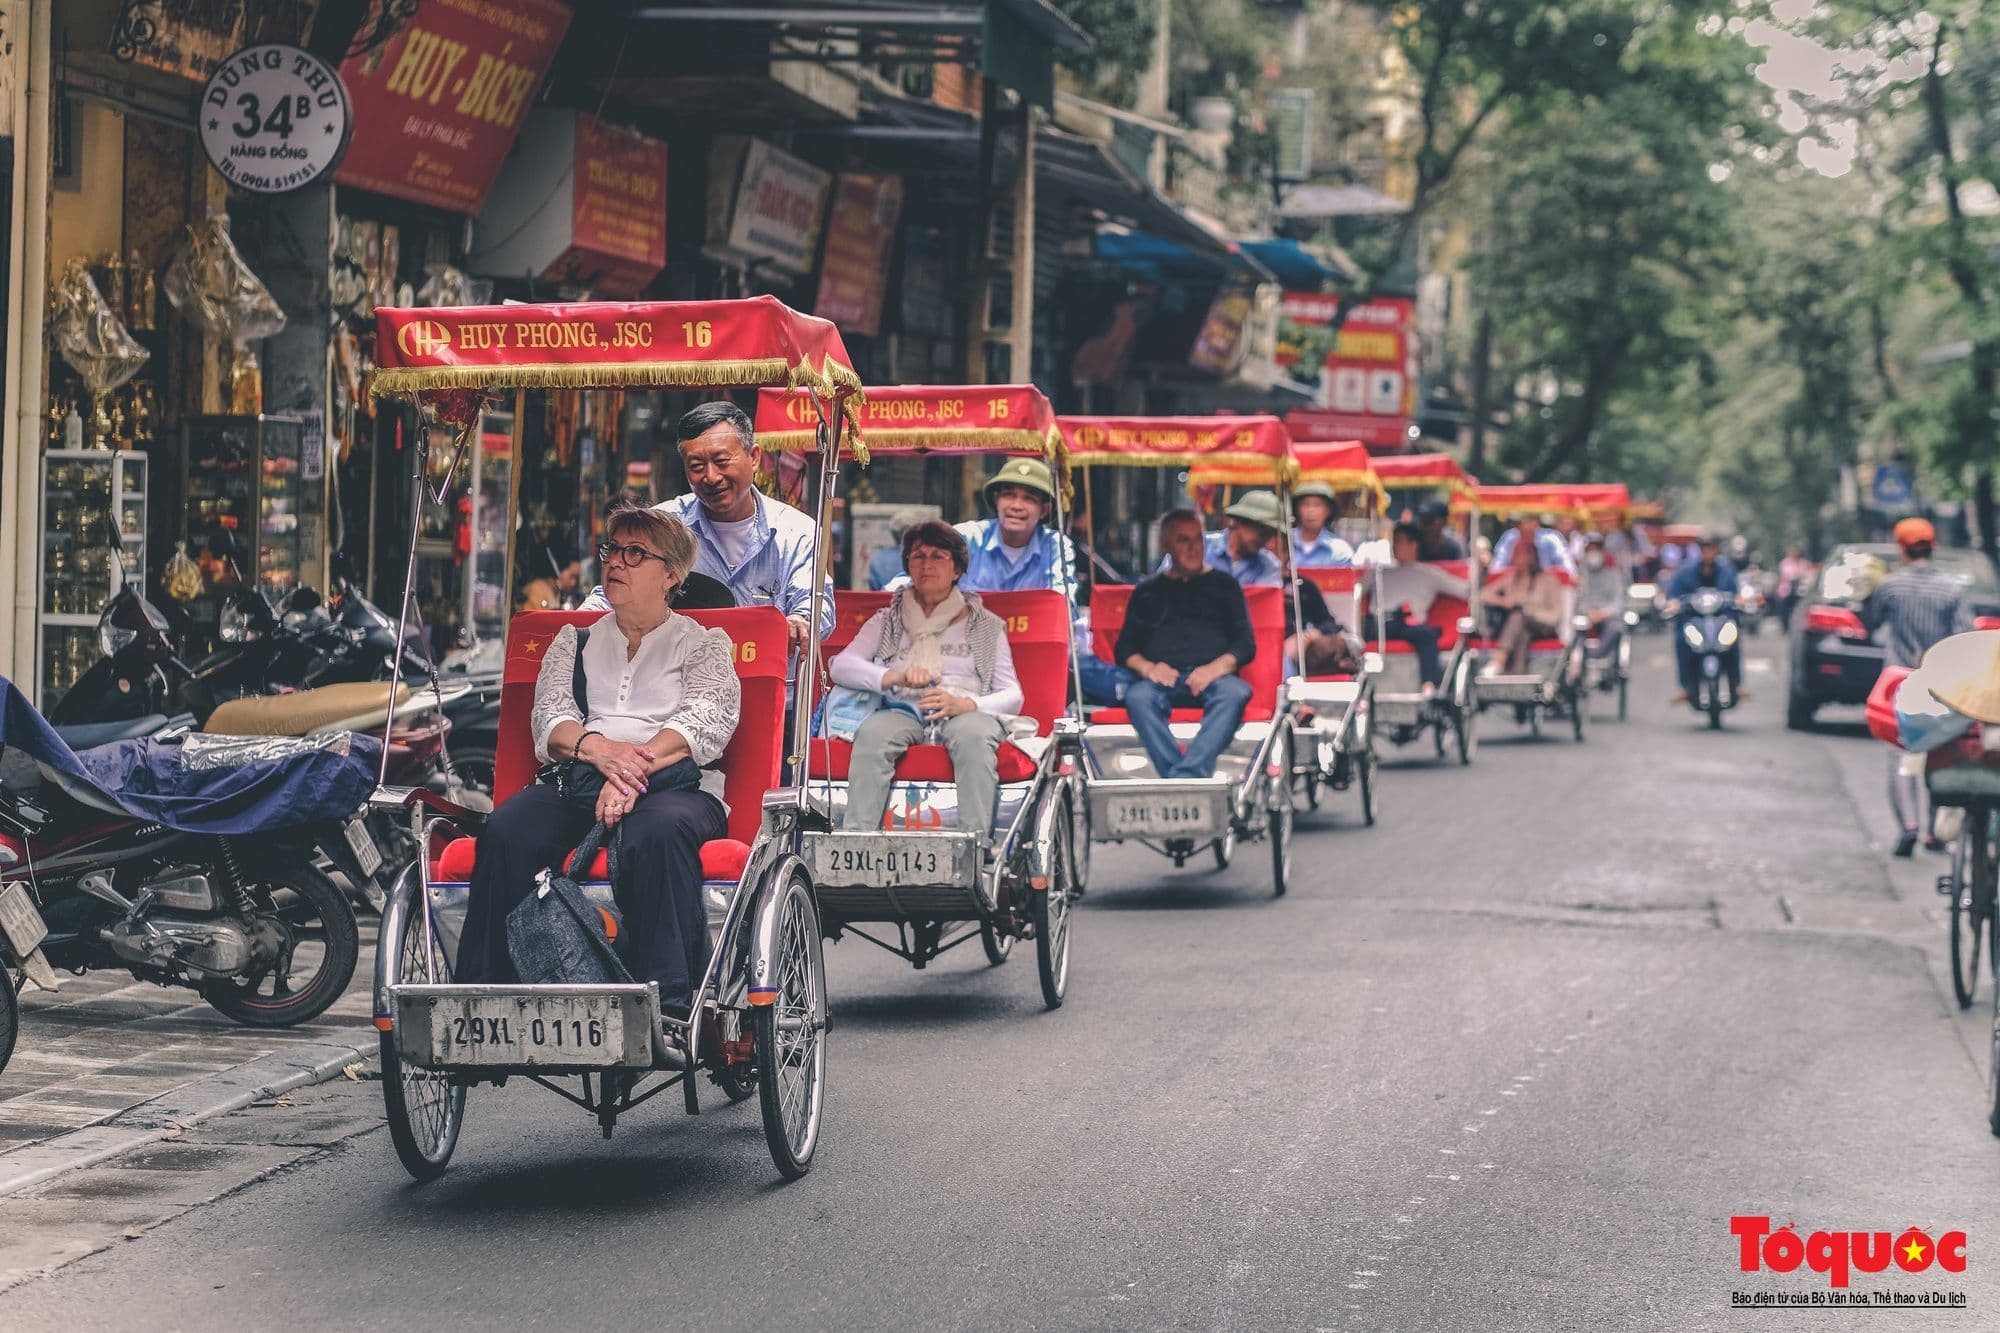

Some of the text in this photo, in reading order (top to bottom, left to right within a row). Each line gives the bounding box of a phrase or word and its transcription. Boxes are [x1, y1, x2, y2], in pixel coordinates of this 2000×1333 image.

[293, 54, 338, 108] THU
[386, 27, 467, 105] HUY
[455, 40, 535, 128] BÍCH
[457, 323, 508, 350] HUY
[612, 321, 653, 348] JSC
[681, 321, 712, 348] 16
[935, 399, 964, 420] JSC
[987, 398, 1009, 419] 15
[1007, 615, 1029, 633] 15
[453, 1017, 602, 1047] 29XL 0116
